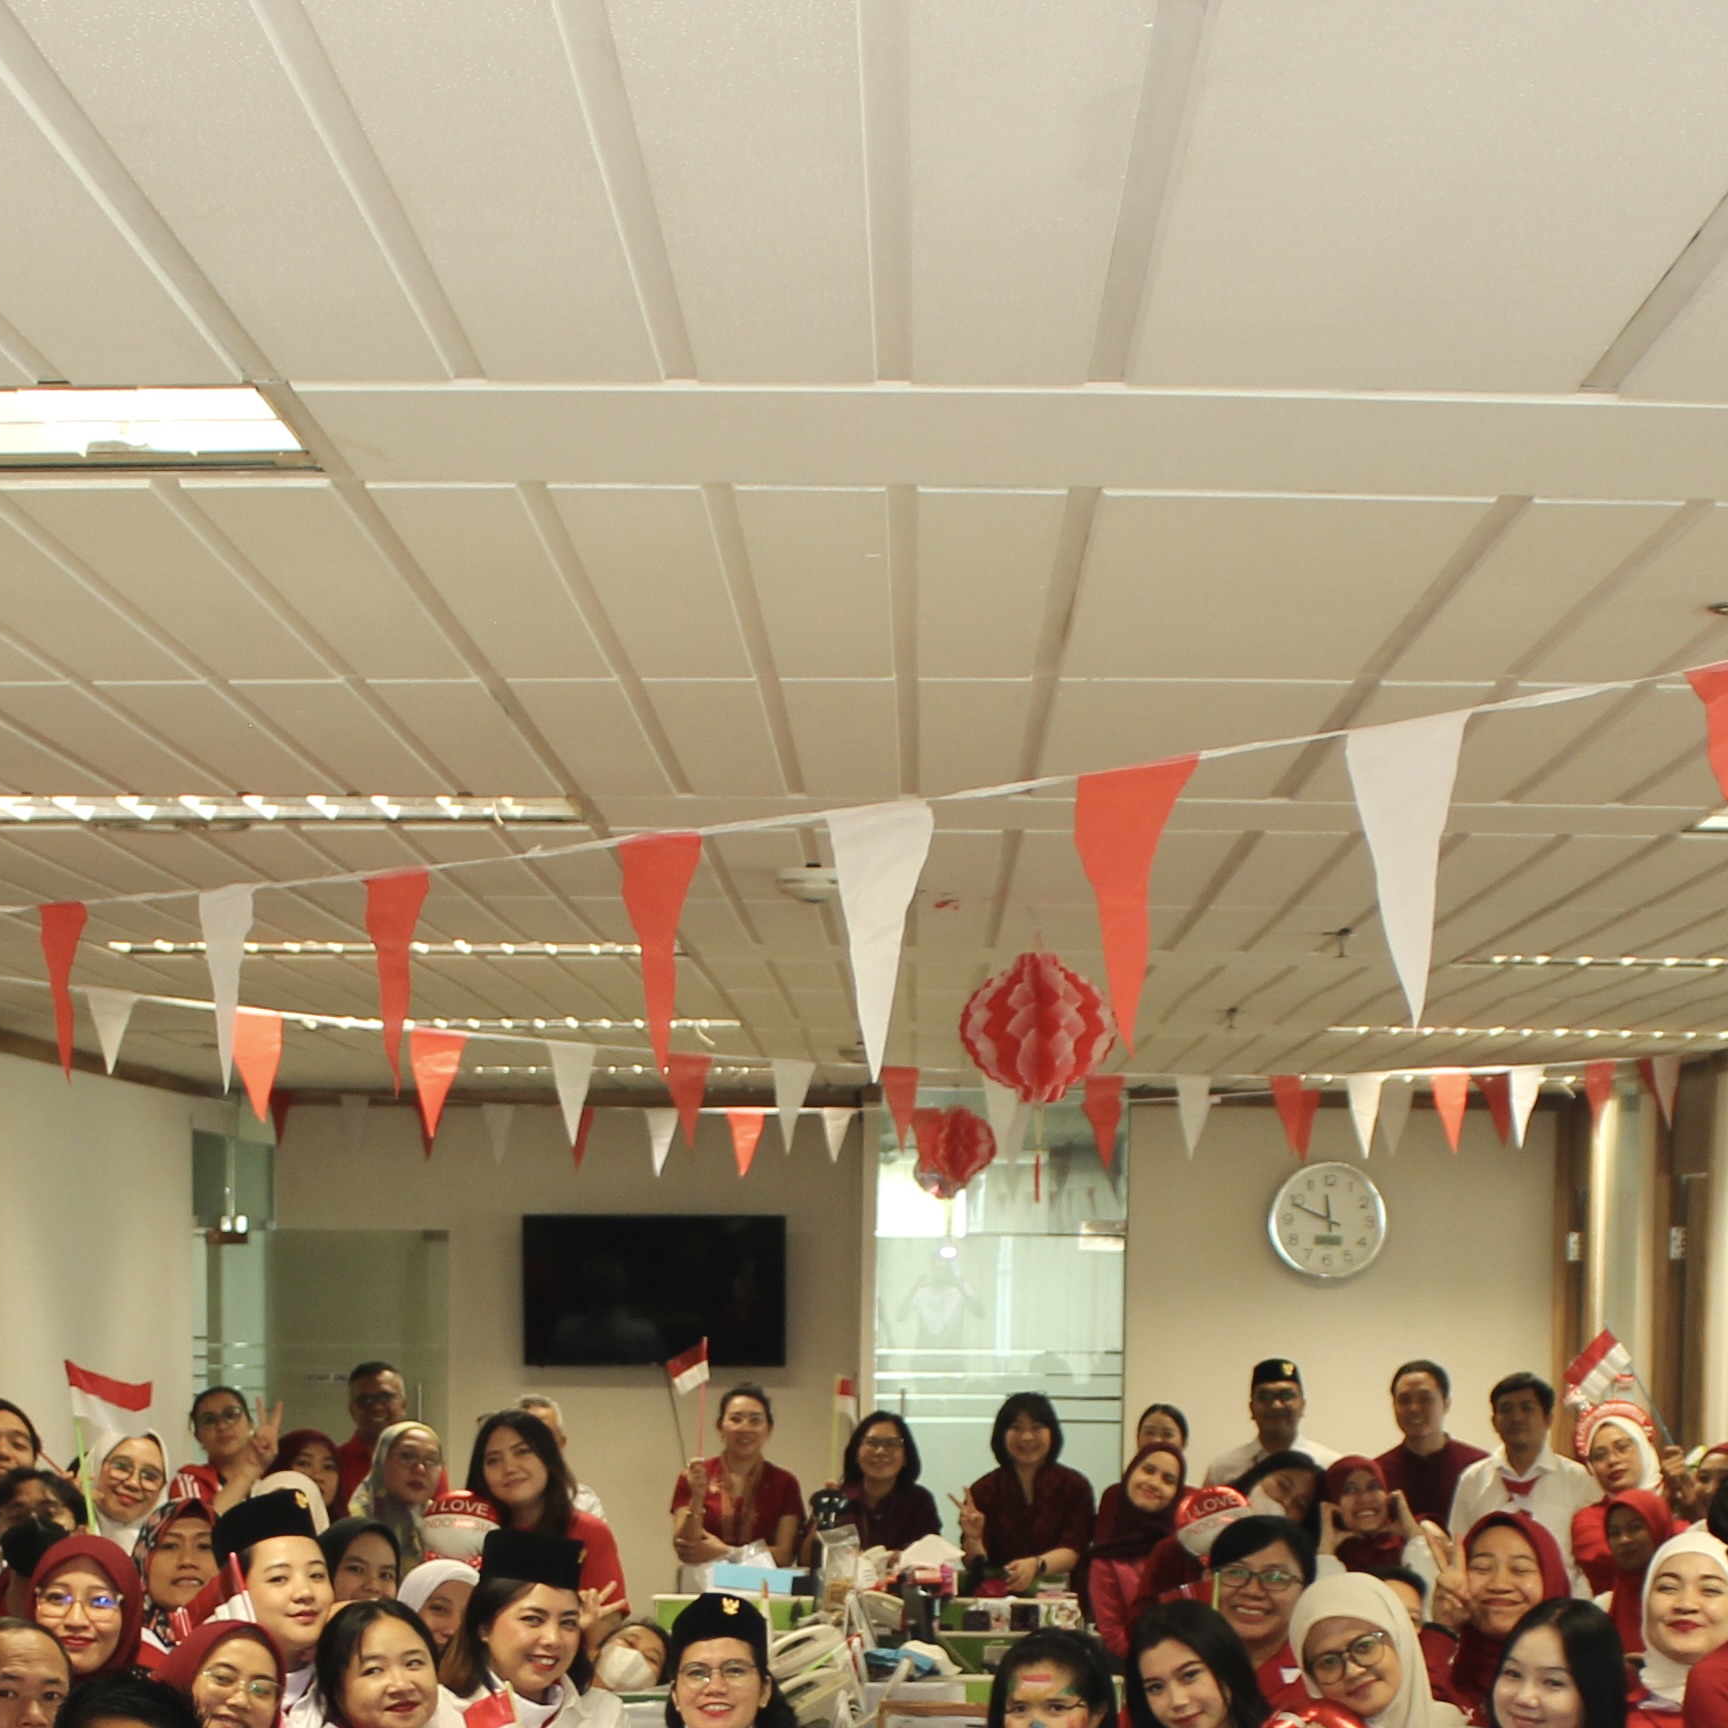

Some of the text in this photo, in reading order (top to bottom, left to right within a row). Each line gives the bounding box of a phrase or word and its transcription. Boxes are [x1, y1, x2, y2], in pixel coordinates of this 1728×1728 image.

[1324, 1174, 1337, 1187] 12
[1348, 1181, 1353, 1192] 1
[1291, 1193, 1305, 1206] 10
[1360, 1196, 1369, 1209] 2
[1284, 1213, 1294, 1225] 9
[1365, 1215, 1374, 1228] 3
[1289, 1233, 1299, 1246] 8
[1357, 1237, 1367, 1248] 4
[1304, 1248, 1313, 1260] 7
[1323, 1254, 1333, 1266] 6
[1344, 1250, 1353, 1262] 5
[440, 1499, 489, 1517] LOVE
[1193, 1494, 1238, 1516] LOVE
